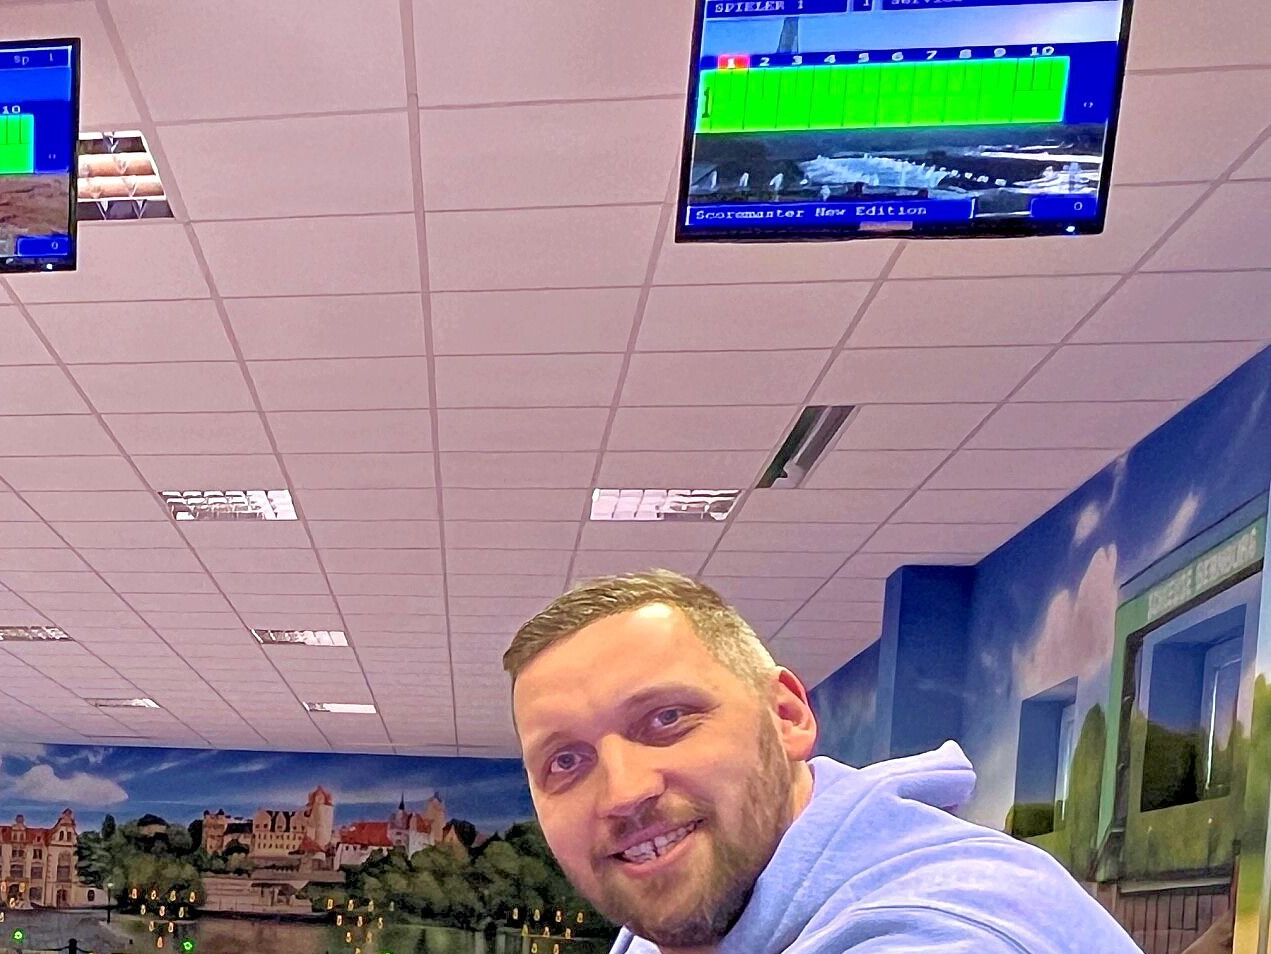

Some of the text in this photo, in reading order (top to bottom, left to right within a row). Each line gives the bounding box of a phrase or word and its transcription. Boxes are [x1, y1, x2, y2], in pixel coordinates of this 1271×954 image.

[728, 46, 1054, 68] 1 2 3 4 5 6 7 8 9 10
[2, 104, 20, 114] 10
[696, 204, 926, 220] Scoremaster New Edition
[1073, 202, 1082, 210] 0
